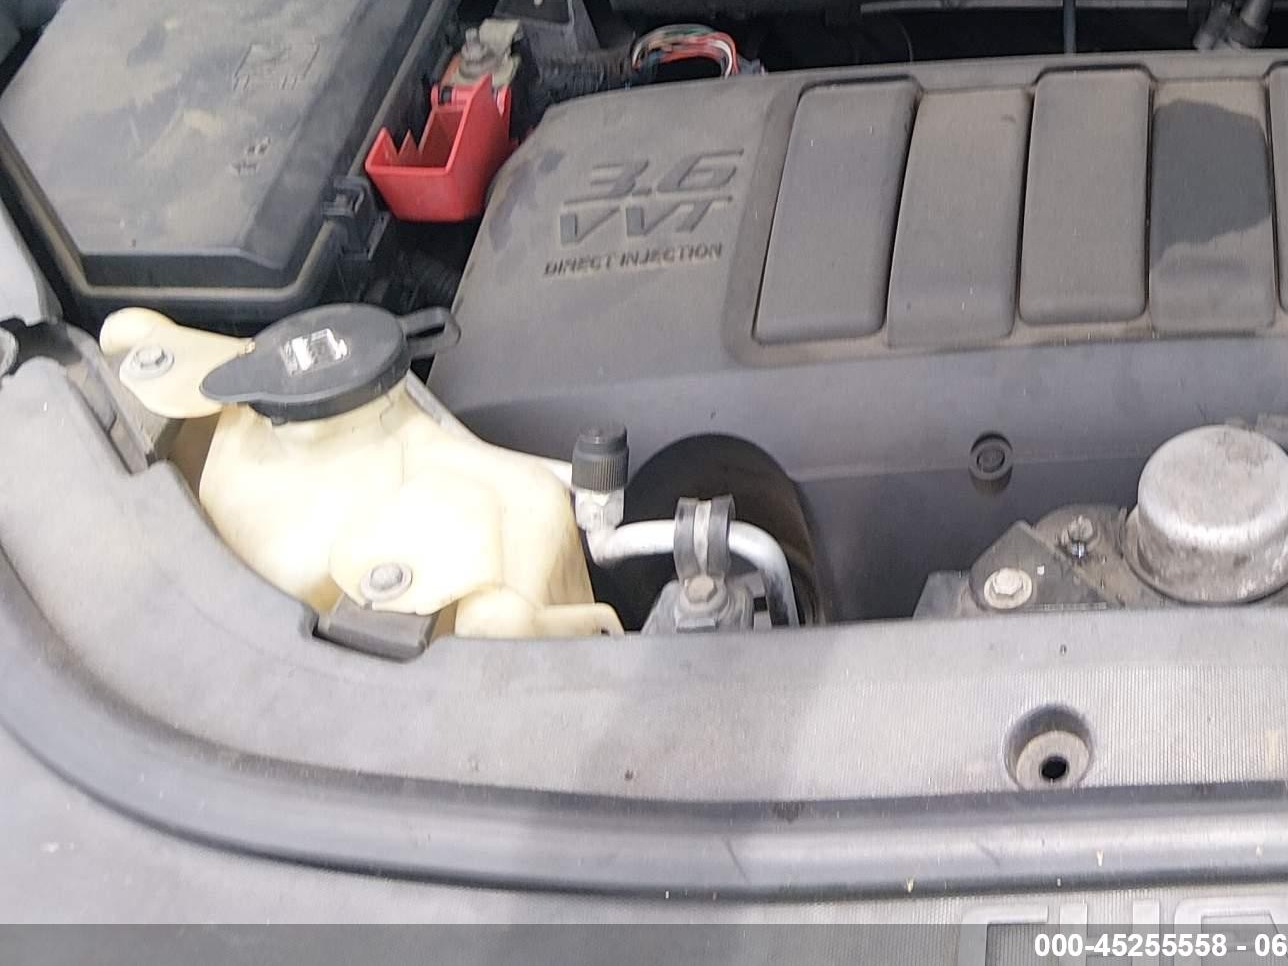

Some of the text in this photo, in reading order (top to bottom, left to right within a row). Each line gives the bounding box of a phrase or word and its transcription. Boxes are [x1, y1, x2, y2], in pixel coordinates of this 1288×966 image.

[564, 147, 745, 205] 3.6
[559, 194, 734, 247] VVT
[543, 241, 723, 276] DIRECT INJECTION
